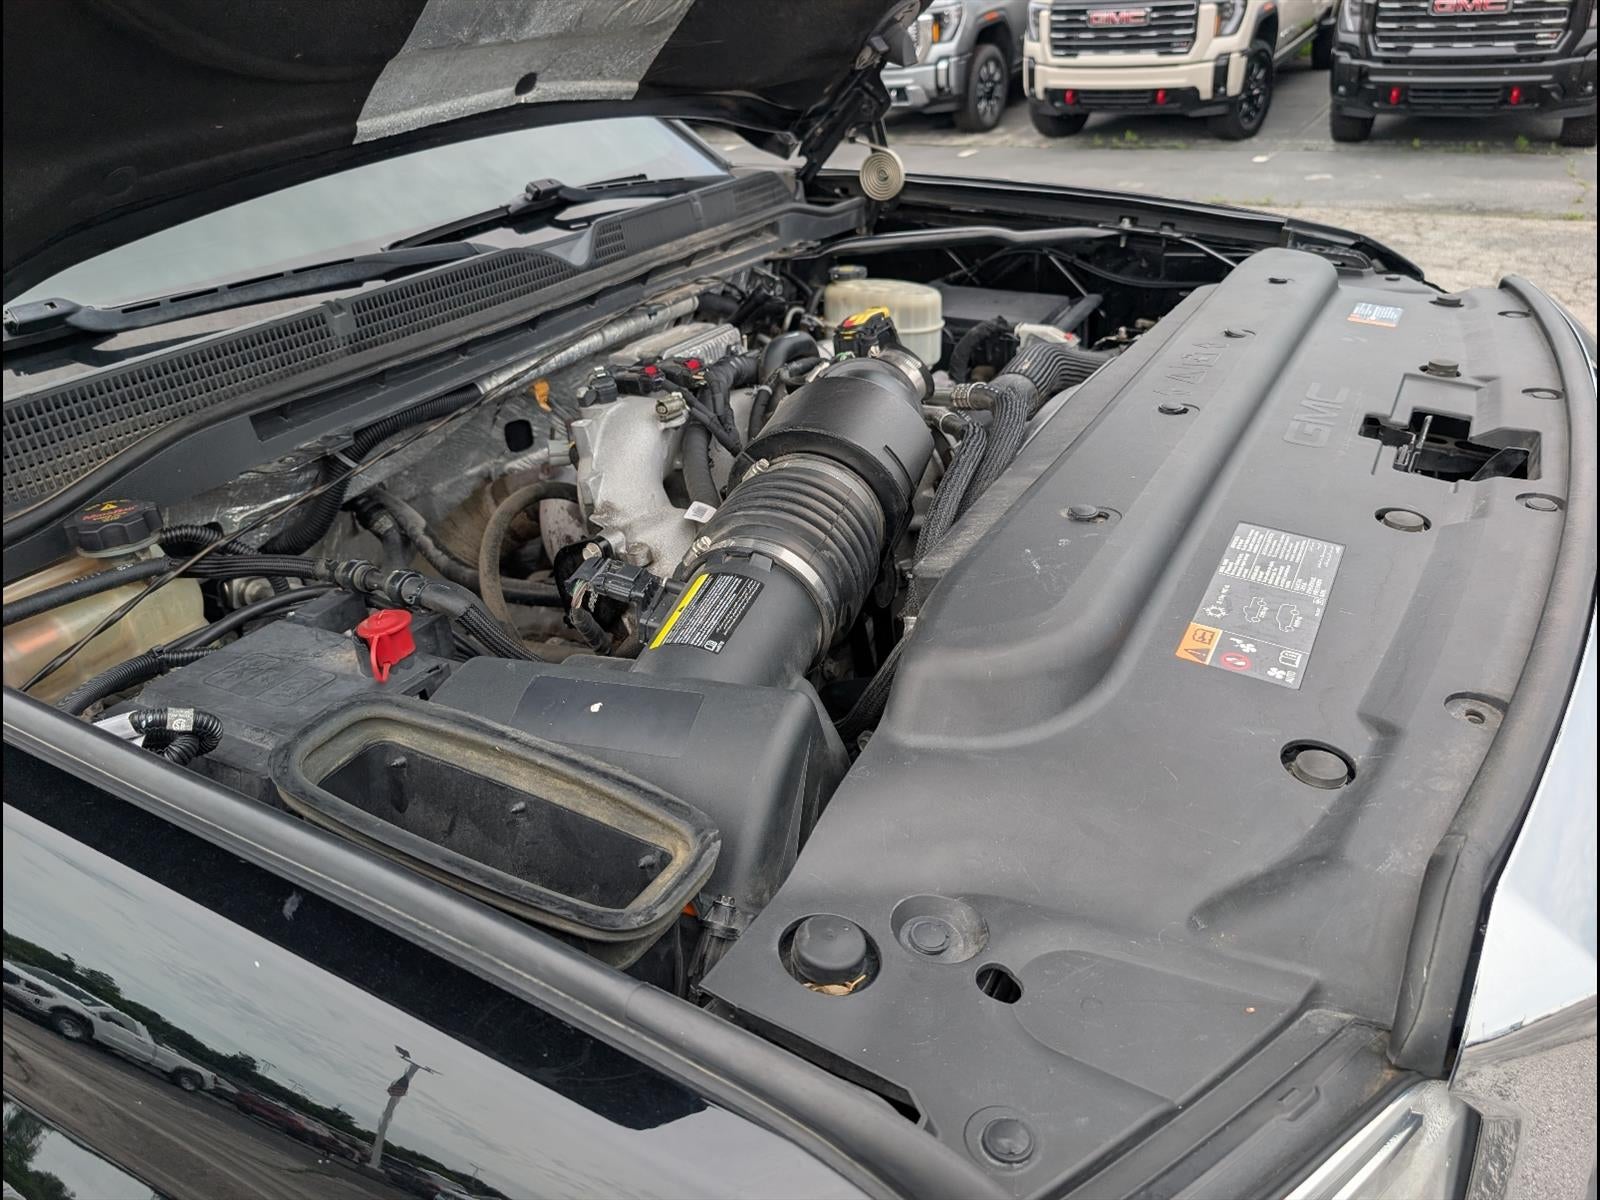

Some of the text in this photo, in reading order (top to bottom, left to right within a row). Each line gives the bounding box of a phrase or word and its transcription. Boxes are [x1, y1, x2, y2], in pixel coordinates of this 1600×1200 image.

[1432, 0, 1506, 13] GMC
[1089, 10, 1147, 25] GMC
[1281, 382, 1350, 449] GMC
